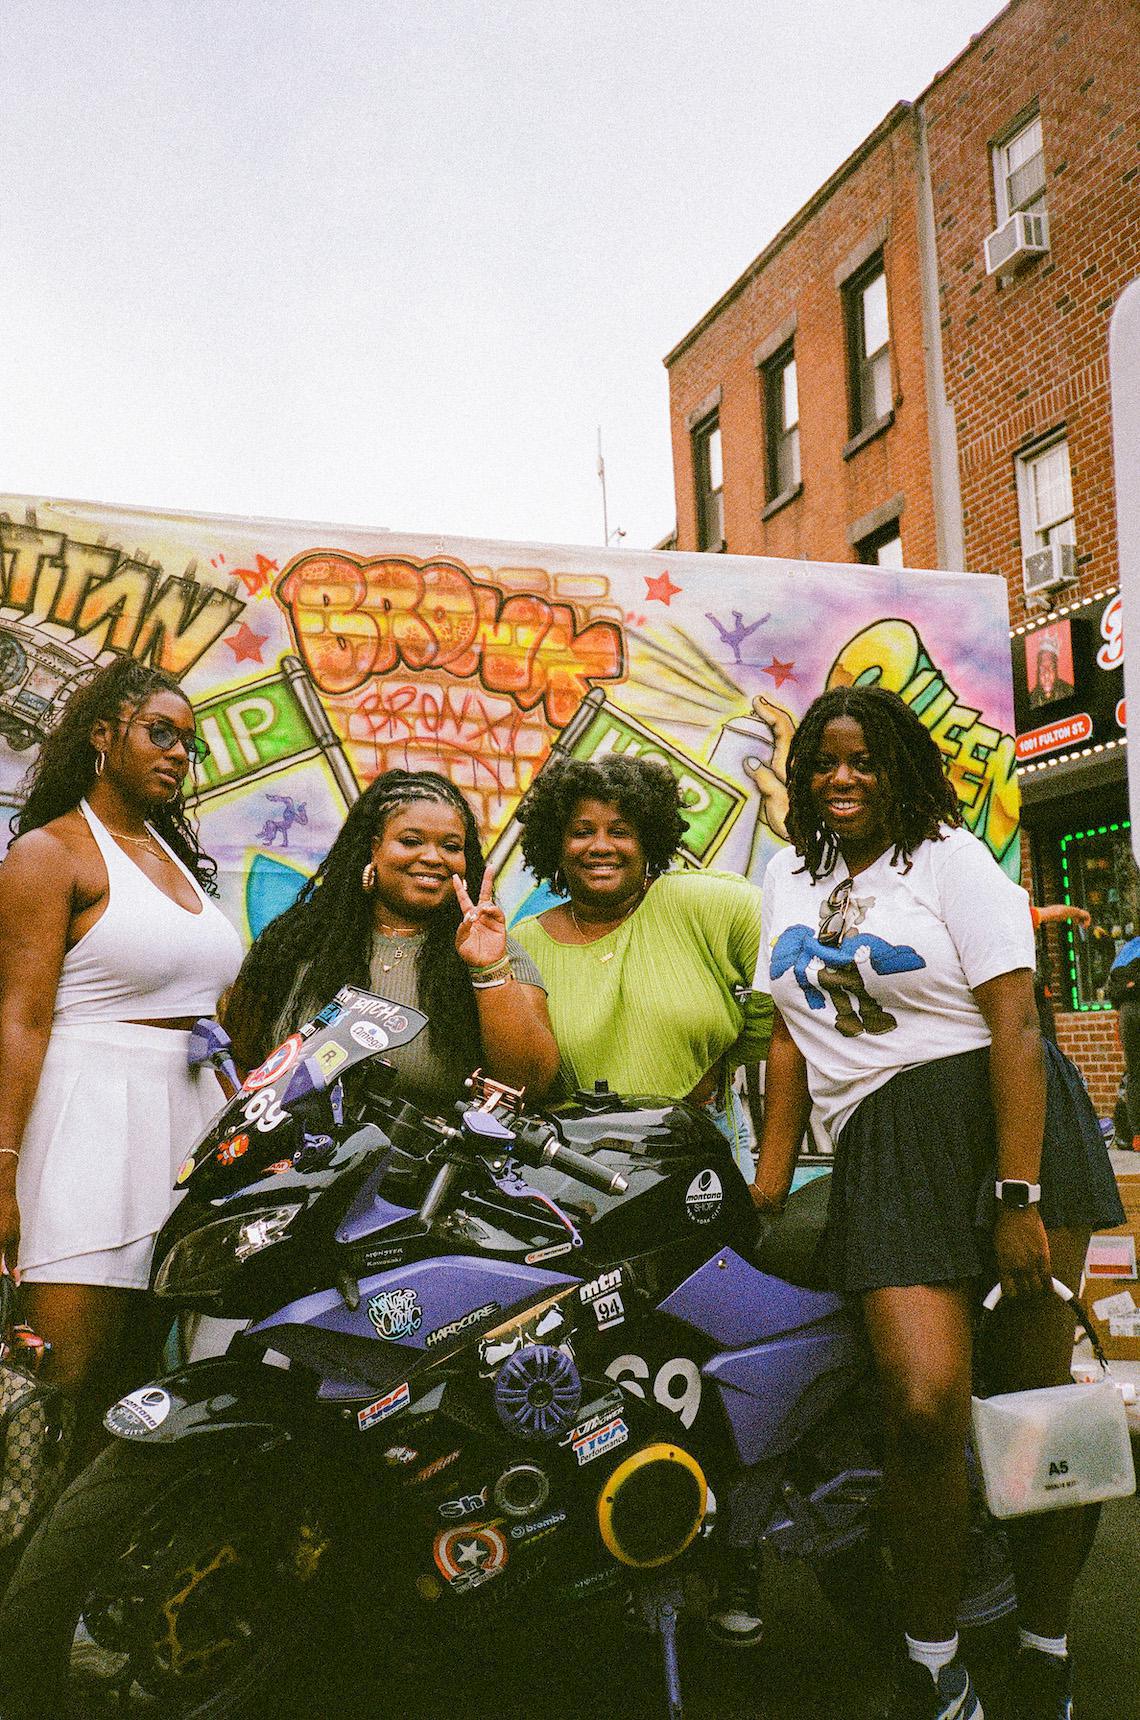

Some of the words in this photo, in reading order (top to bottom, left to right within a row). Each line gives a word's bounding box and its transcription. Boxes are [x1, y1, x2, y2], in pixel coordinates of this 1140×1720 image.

[189, 696, 275, 785] IP
[1039, 725, 1071, 746] FULTON
[598, 1298, 620, 1321] 94
[1048, 1460, 1069, 1476] A5
[525, 1512, 567, 1533] brembo
